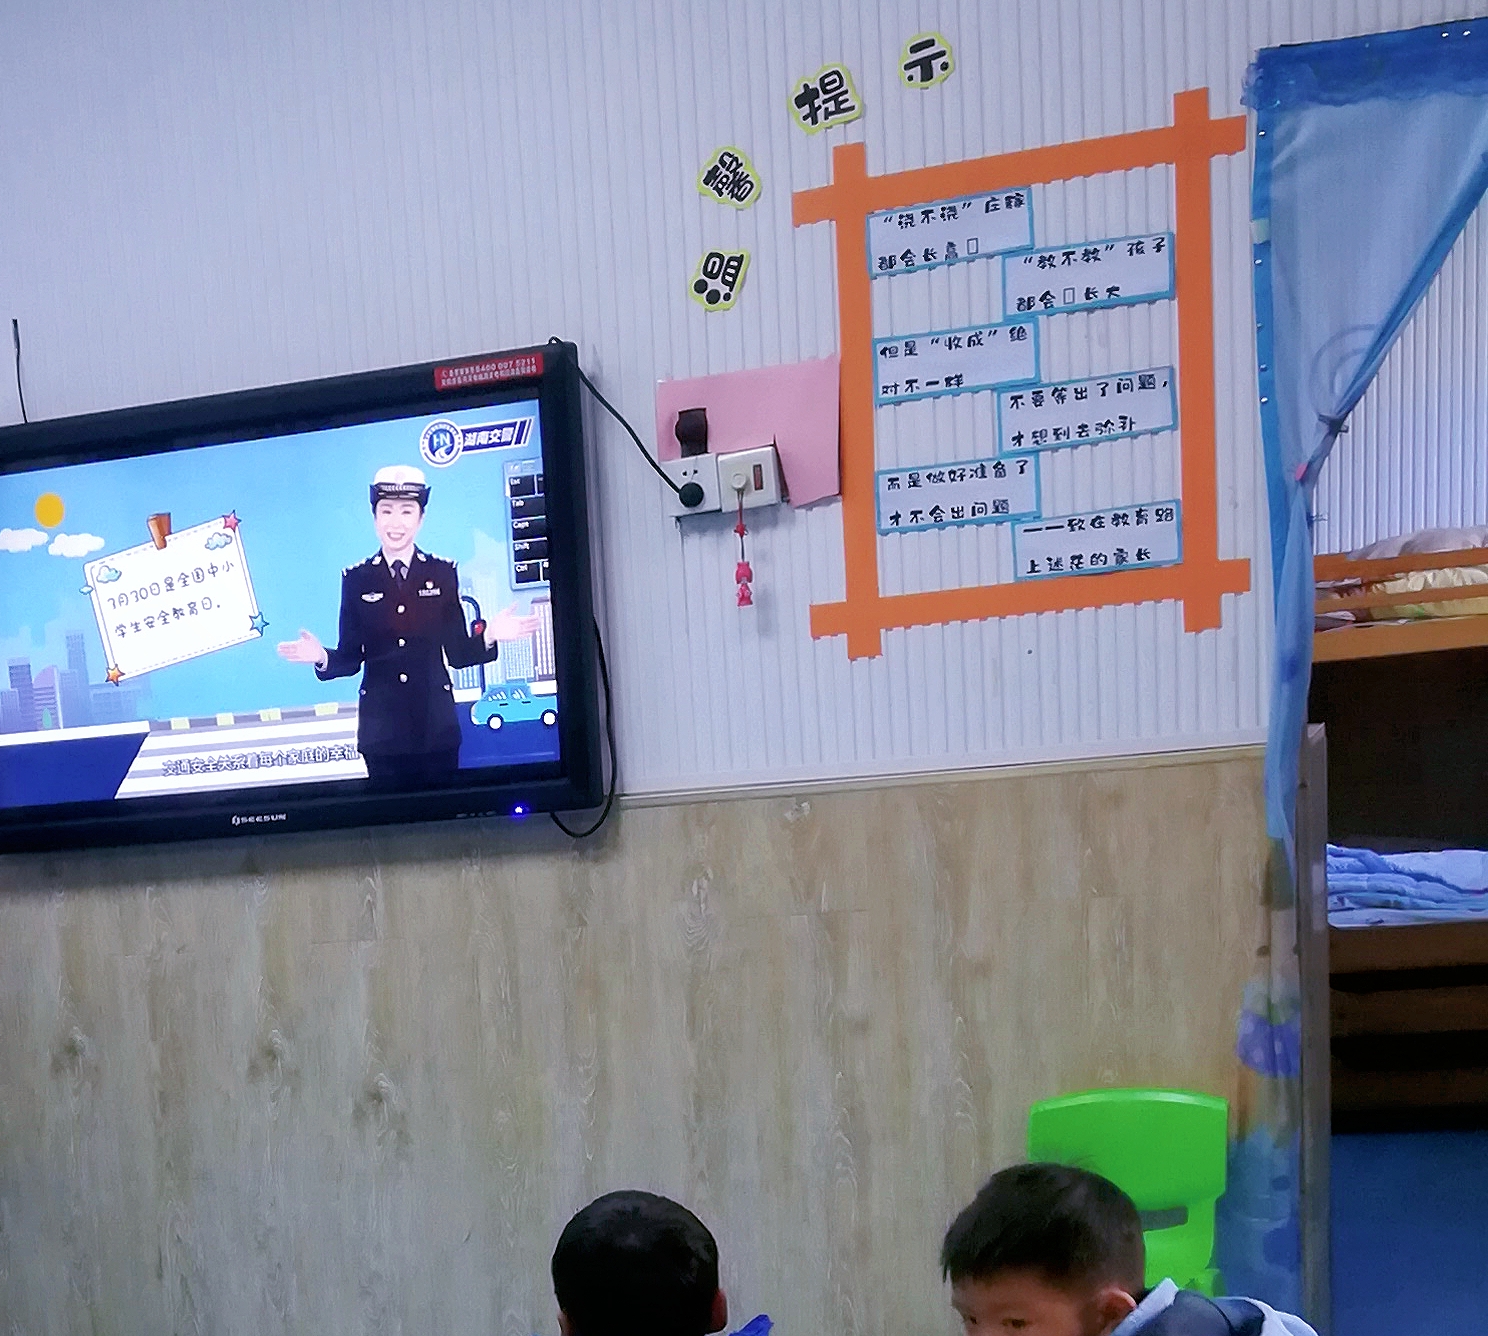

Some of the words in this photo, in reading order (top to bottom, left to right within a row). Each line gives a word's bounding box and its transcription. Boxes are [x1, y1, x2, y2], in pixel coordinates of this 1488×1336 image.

[881, 373, 964, 396] 对不一样
[889, 498, 1010, 526] 才不会出问题
